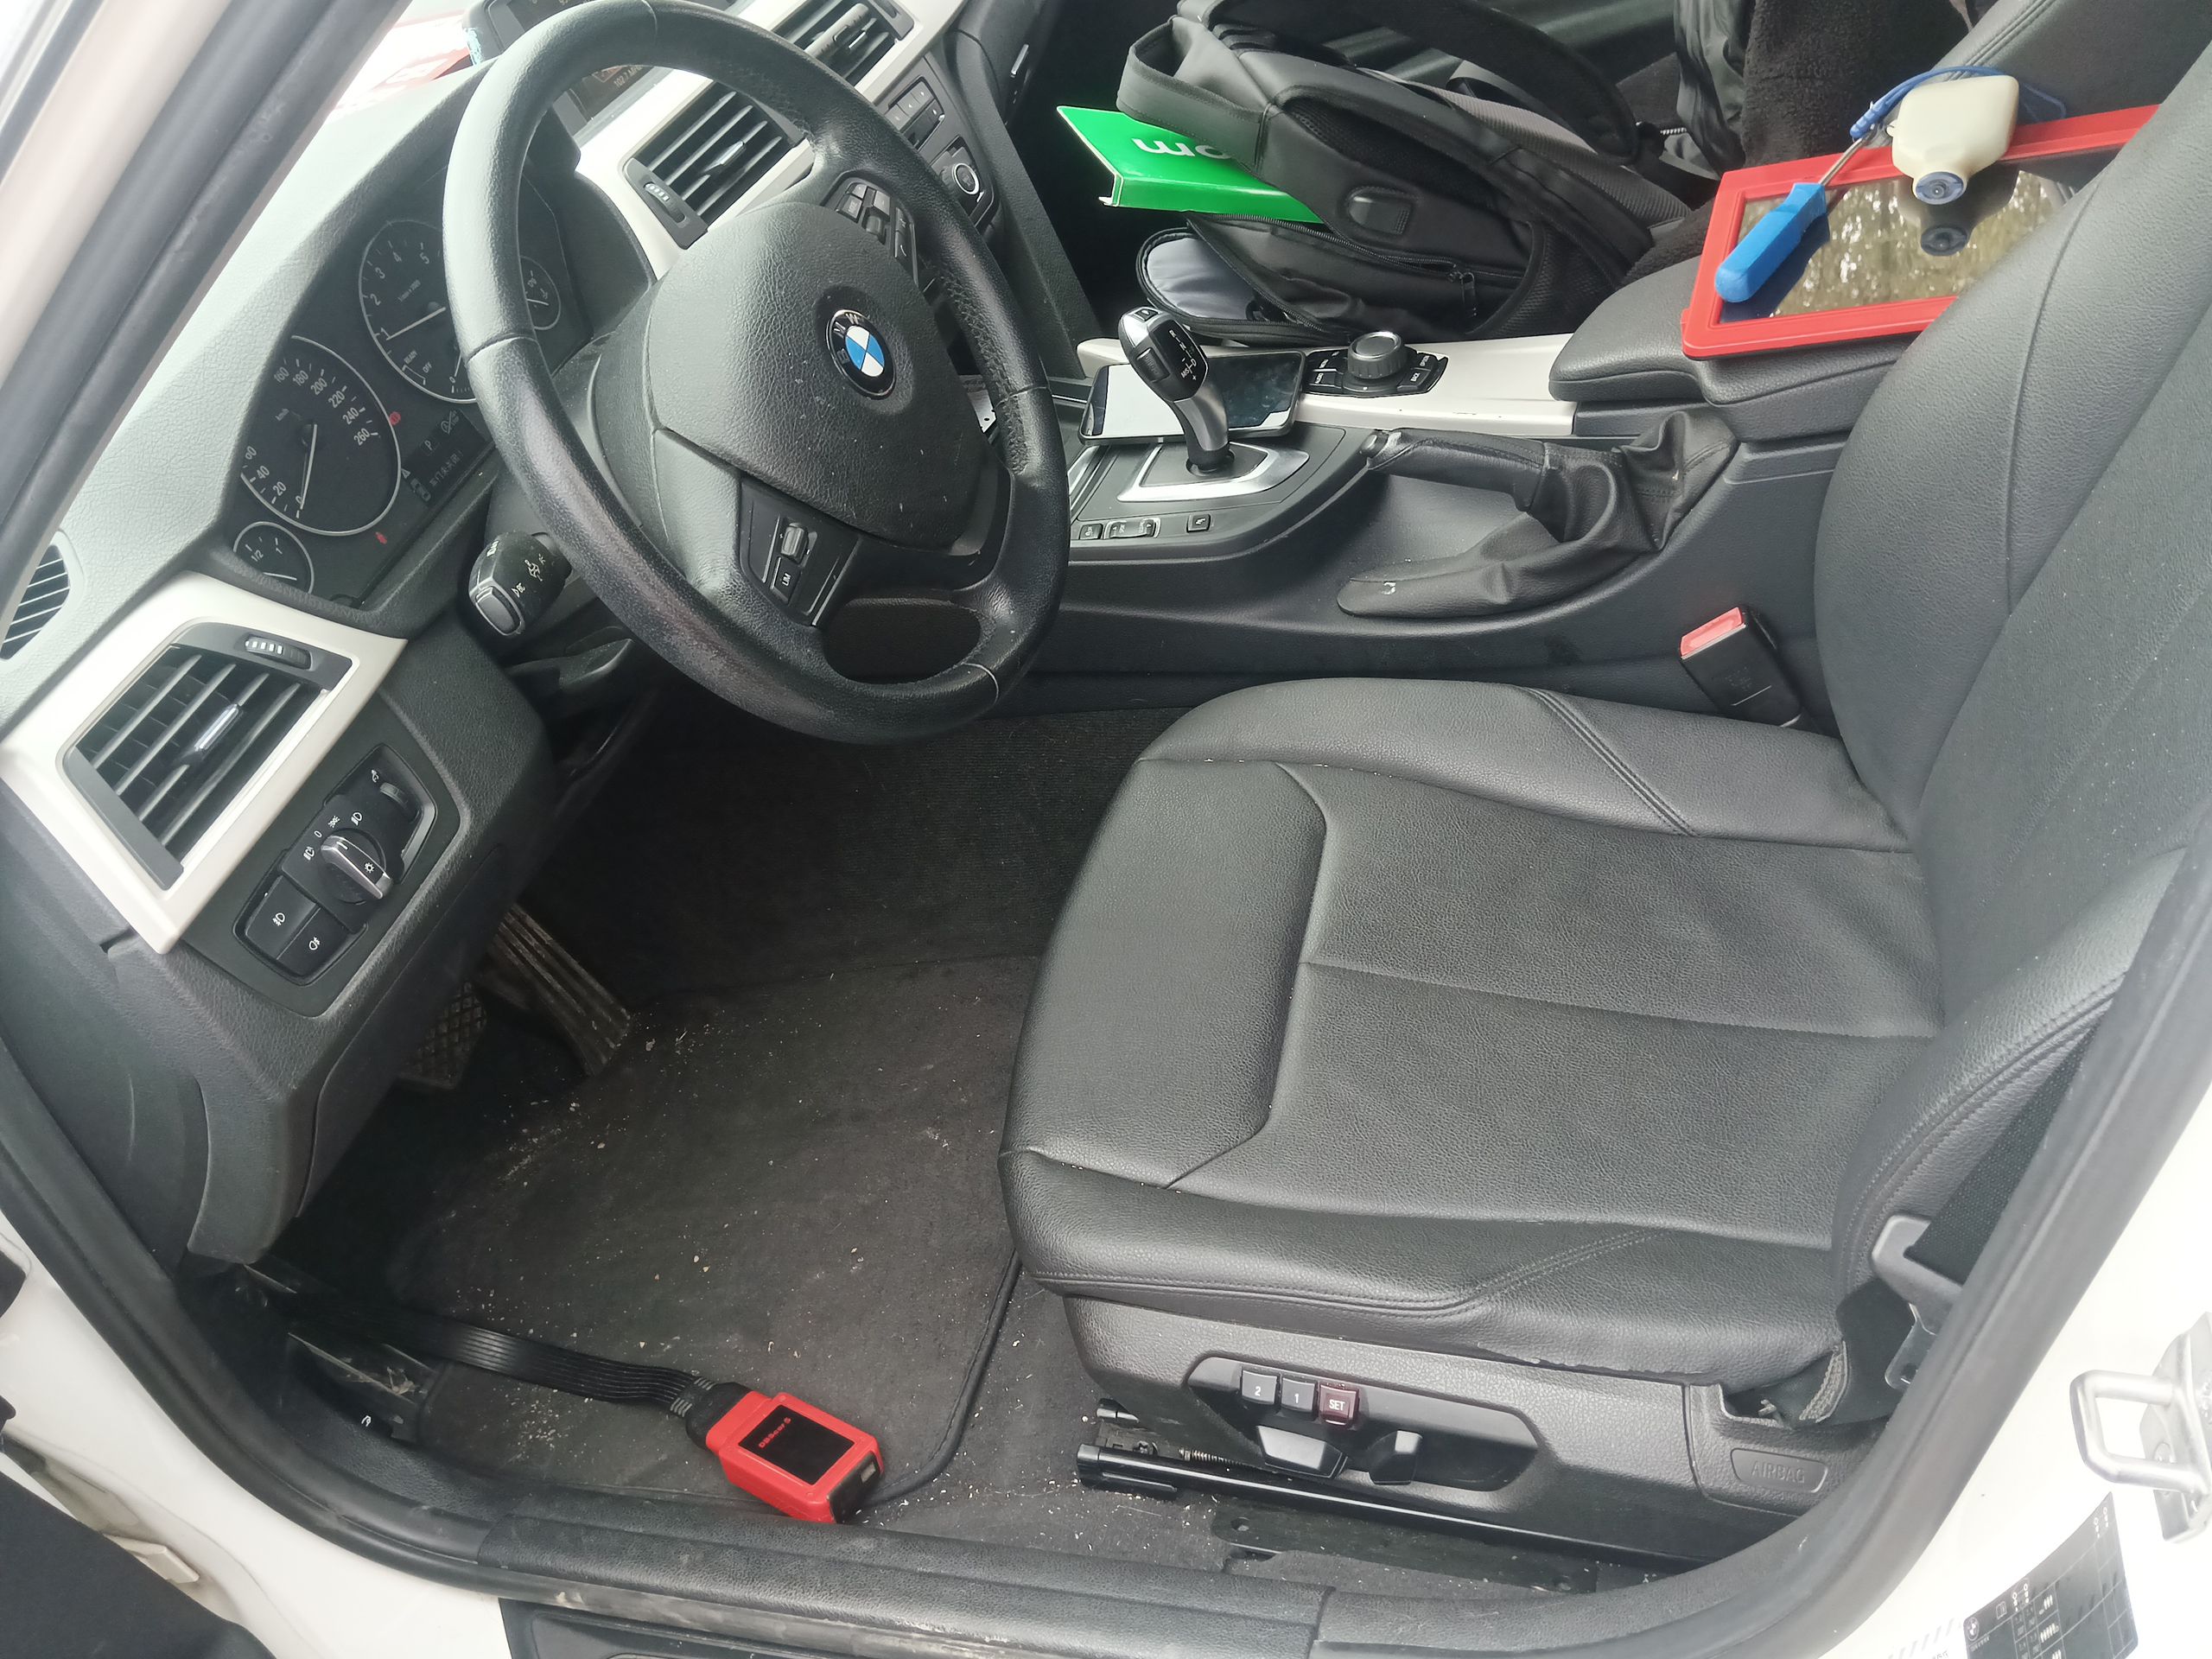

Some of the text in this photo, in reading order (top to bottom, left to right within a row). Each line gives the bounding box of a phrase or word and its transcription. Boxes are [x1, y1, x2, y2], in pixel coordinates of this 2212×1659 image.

[392, 251, 402, 263] 4
[420, 252, 430, 264] 5
[375, 267, 385, 279] 3
[370, 294, 381, 306] 2
[404, 350, 417, 365] READY
[274, 366, 289, 383] 160
[423, 362, 432, 373] OFF
[292, 370, 309, 386] 180
[310, 378, 327, 396] 200
[328, 391, 346, 409] 220
[342, 407, 359, 425] 240
[353, 428, 371, 446] 260
[424, 440, 433, 450] P
[257, 466, 270, 480] 40
[273, 481, 287, 496] 20
[251, 550, 264, 562] 1/2
[1254, 1386, 1262, 1396] 2
[1294, 1393, 1300, 1403] 1
[1329, 1398, 1346, 1412] SET
[1751, 1459, 1806, 1484] AIRBAG
